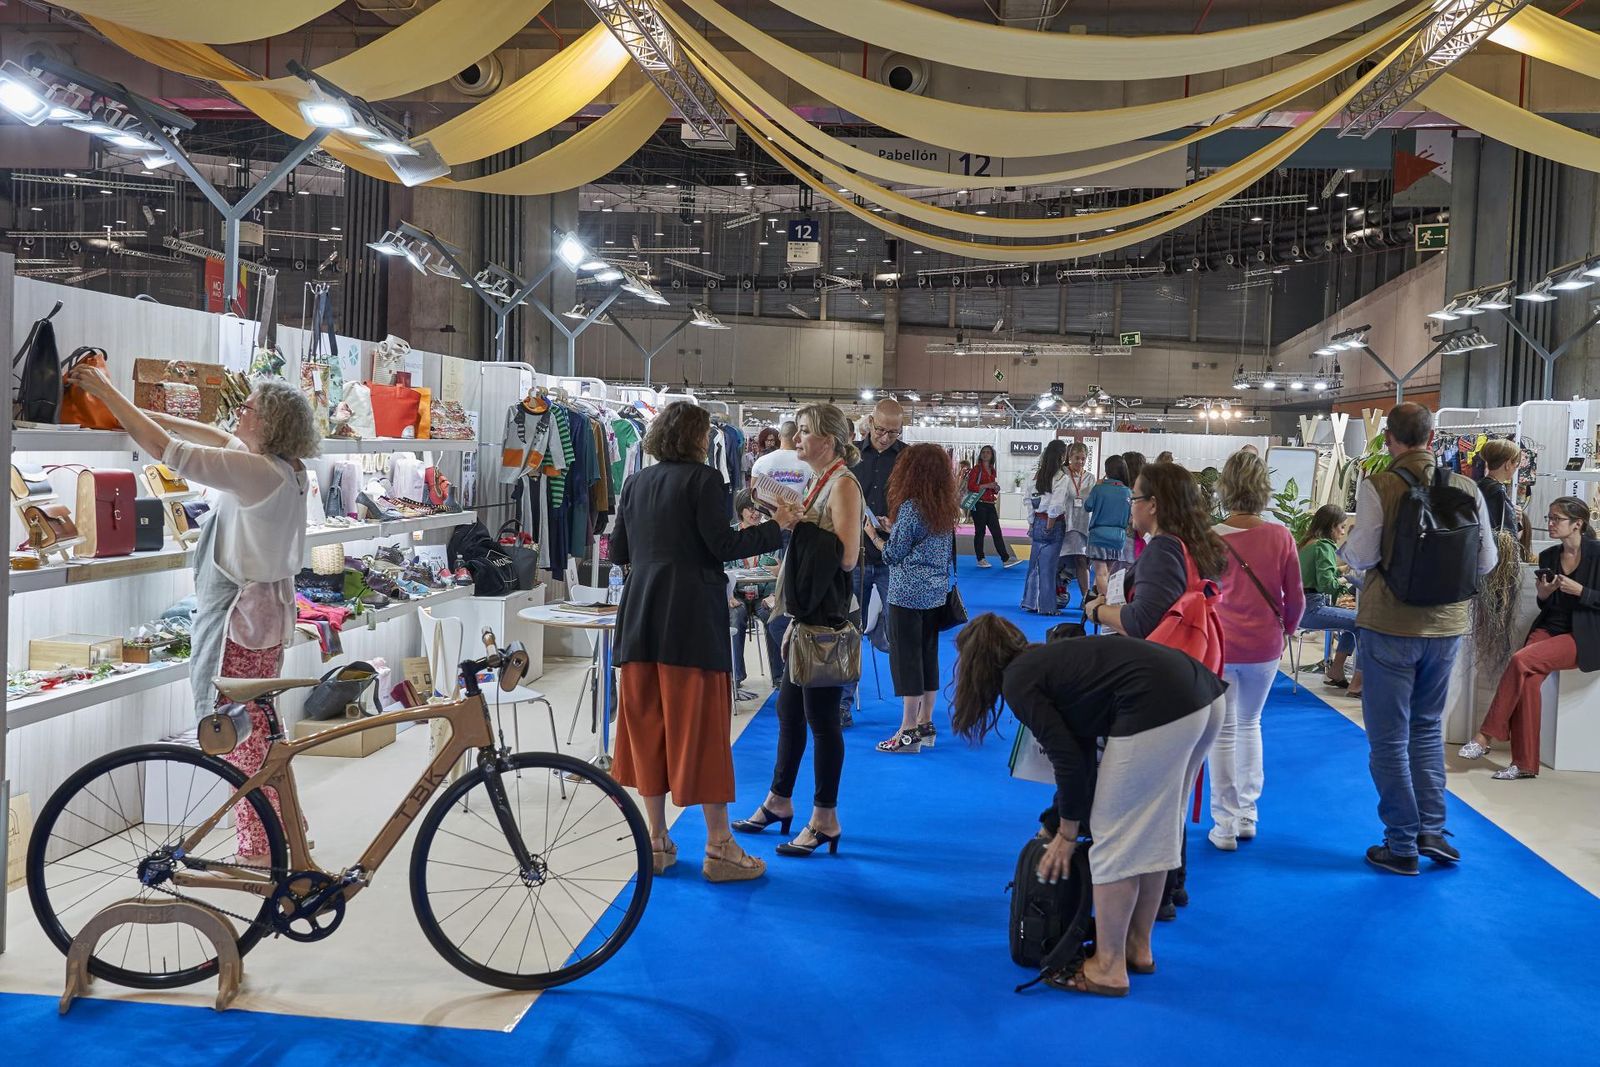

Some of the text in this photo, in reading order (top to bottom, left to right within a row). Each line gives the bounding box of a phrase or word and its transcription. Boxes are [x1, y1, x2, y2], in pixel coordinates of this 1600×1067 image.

[878, 149, 991, 176] Pabellón 12
[251, 207, 261, 221] 12
[795, 224, 812, 239] 12
[394, 767, 445, 820] TBK
